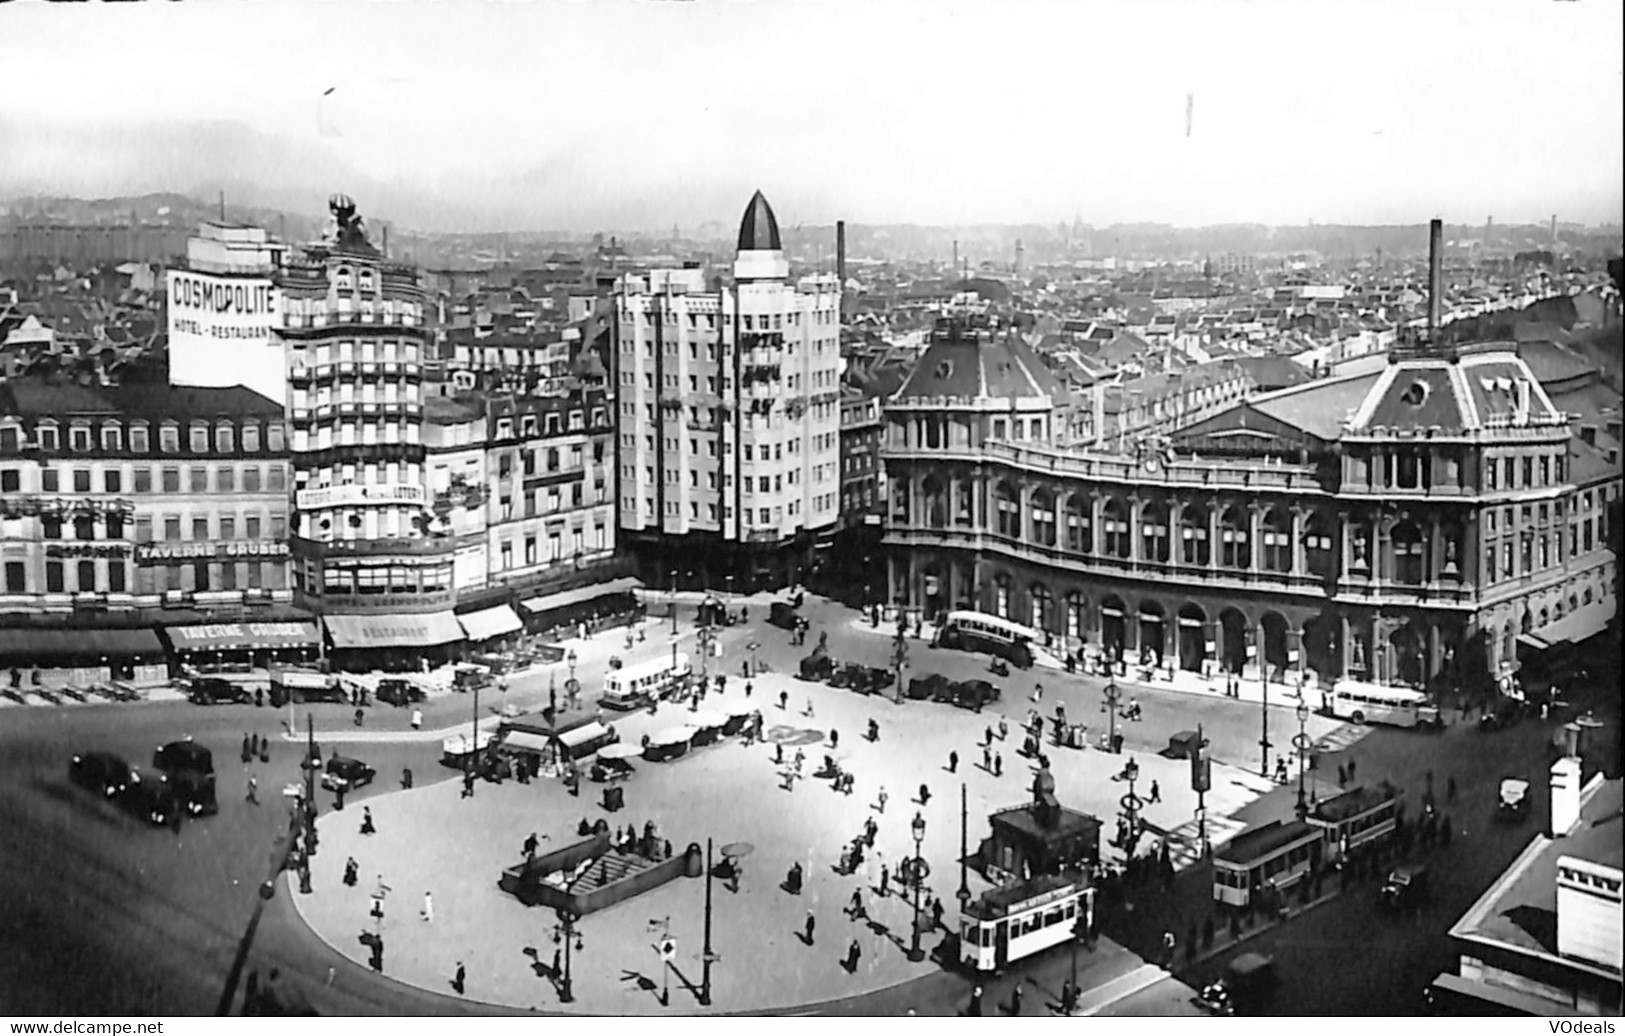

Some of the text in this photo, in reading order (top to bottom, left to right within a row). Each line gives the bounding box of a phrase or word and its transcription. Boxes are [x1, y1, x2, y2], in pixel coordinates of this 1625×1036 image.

[174, 277, 275, 314] COSMOPOLITE
[174, 319, 203, 336] HOTEL
[139, 543, 216, 559] TAVERNE
[226, 543, 290, 556] GRUBER
[178, 621, 306, 640] TAVERNE GRUBER
